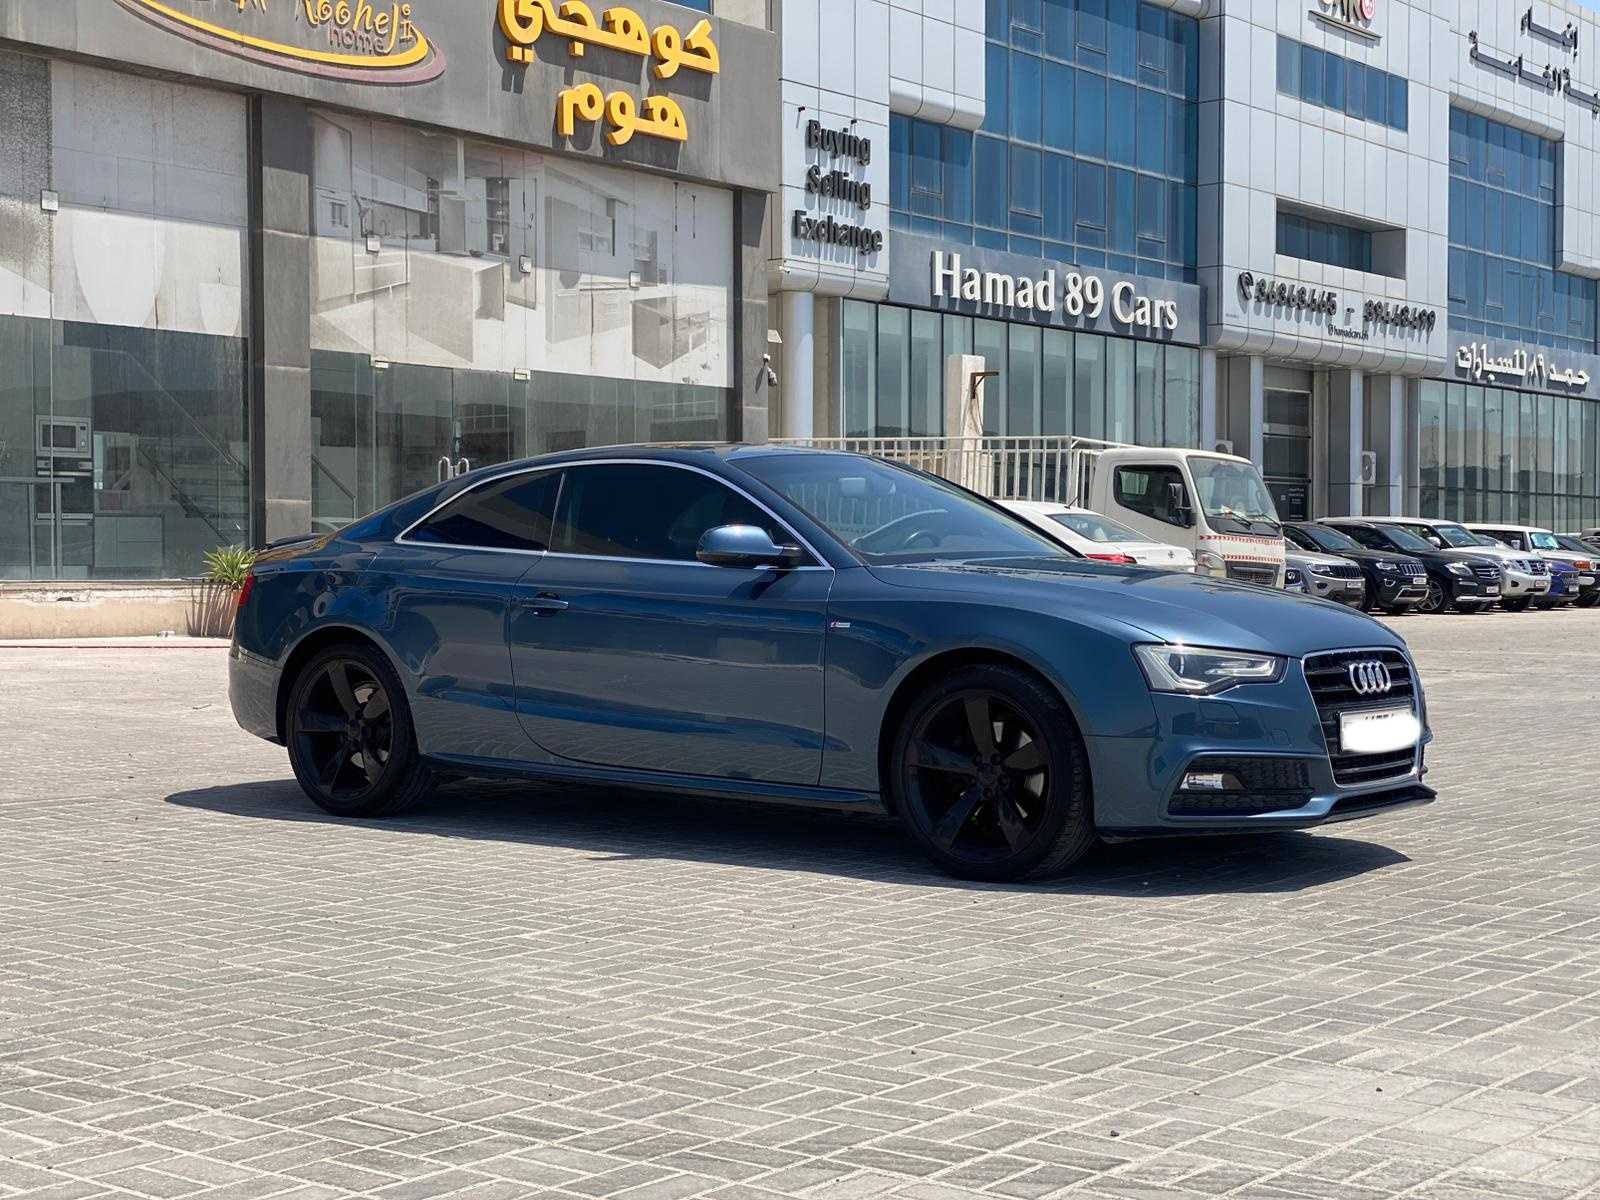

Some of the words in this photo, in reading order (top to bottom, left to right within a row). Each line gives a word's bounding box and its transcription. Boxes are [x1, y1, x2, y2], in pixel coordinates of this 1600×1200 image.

[498, 0, 720, 79] كوهجي
[557, 82, 688, 146] هوم
[807, 119, 871, 166] Buying
[807, 165, 871, 210] Selling
[794, 209, 883, 255] Exchange
[932, 250, 1056, 312] Hamad
[1064, 272, 1104, 319] 89
[1111, 281, 1179, 330] Cars
[1456, 342, 1527, 381] للسيارات
[1549, 363, 1590, 387] حمد
